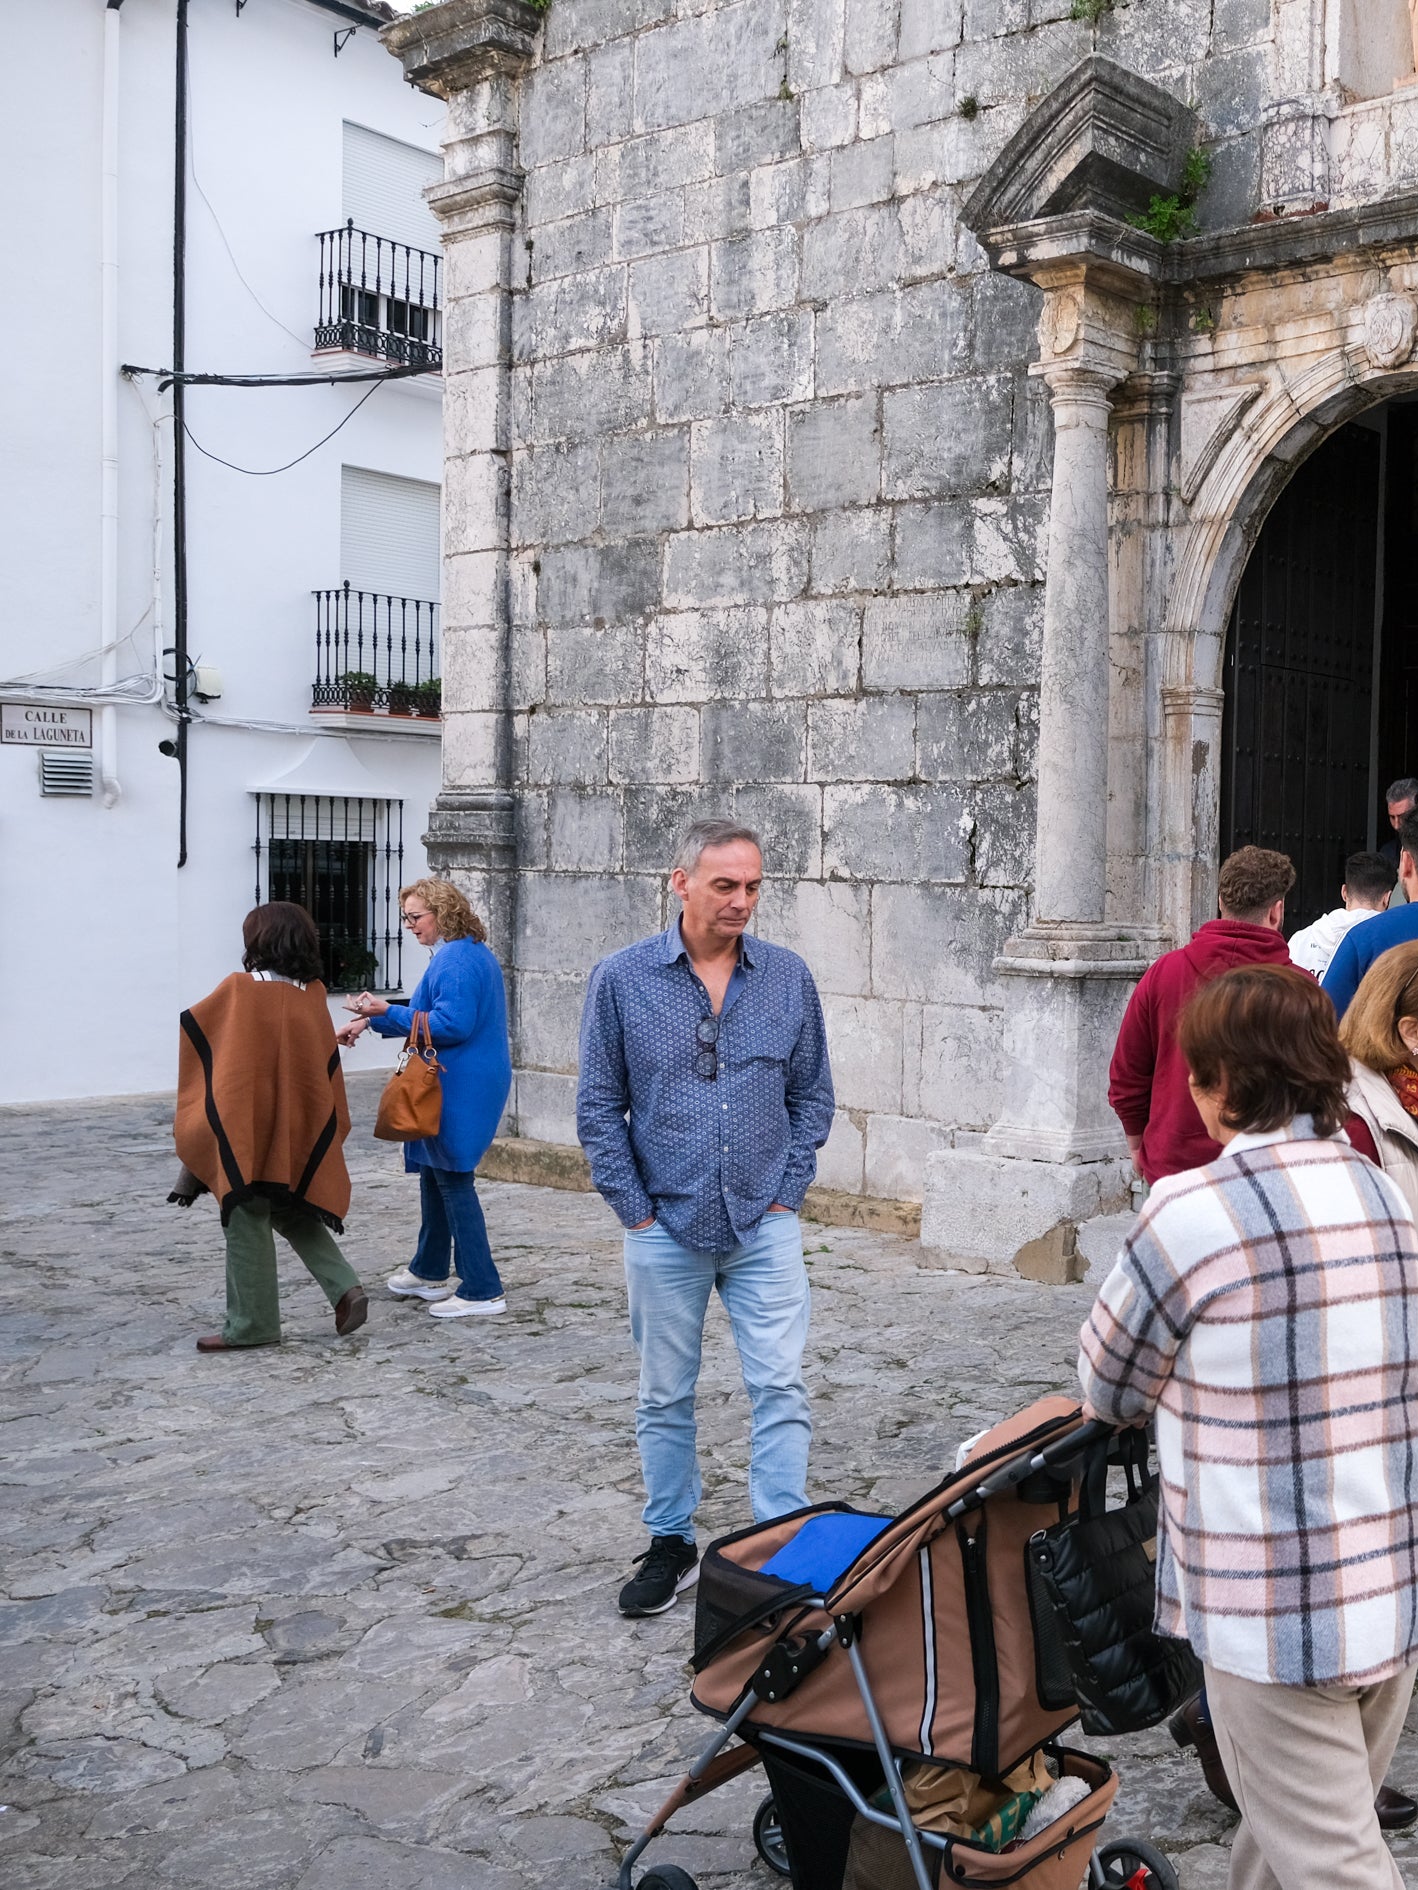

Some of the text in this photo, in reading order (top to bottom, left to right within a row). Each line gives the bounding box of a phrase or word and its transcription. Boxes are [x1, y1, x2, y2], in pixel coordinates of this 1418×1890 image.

[25, 711, 67, 724] CALLE
[6, 728, 85, 742] DE LA LAGUNETA
